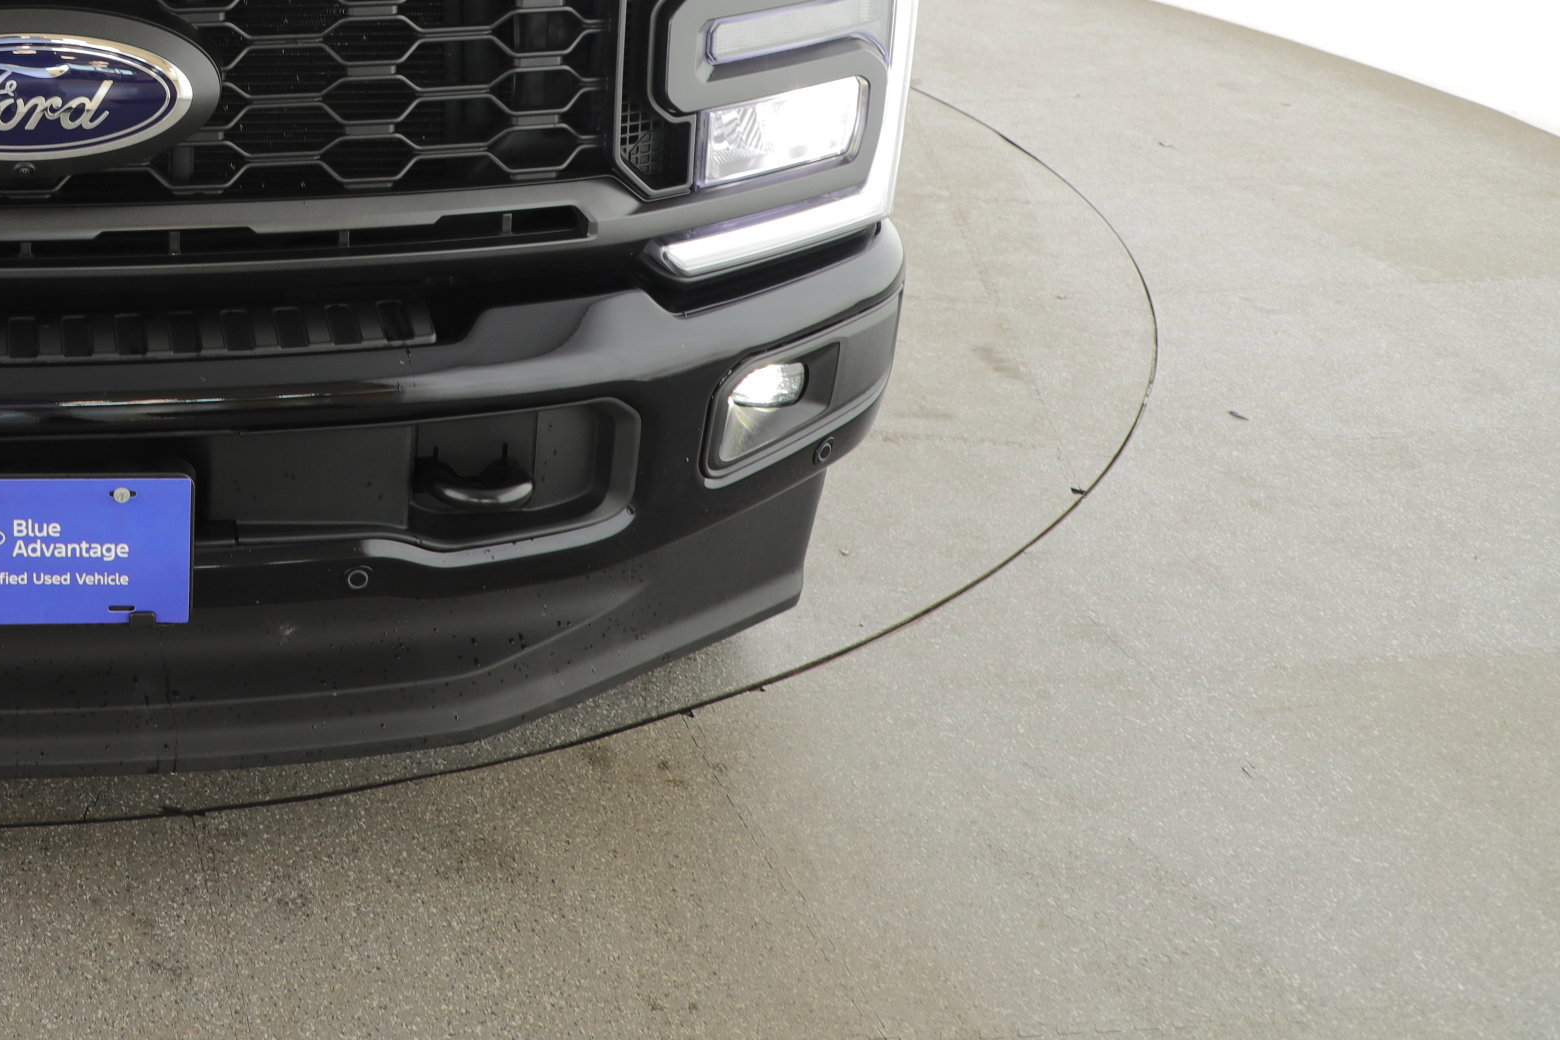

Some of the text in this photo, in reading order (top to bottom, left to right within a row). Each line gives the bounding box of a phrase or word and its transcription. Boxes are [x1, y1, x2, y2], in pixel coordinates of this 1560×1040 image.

[12, 518, 61, 538] Blue
[12, 540, 129, 562] Advantage
[32, 572, 71, 586] Used
[76, 571, 129, 586] Vehicle
